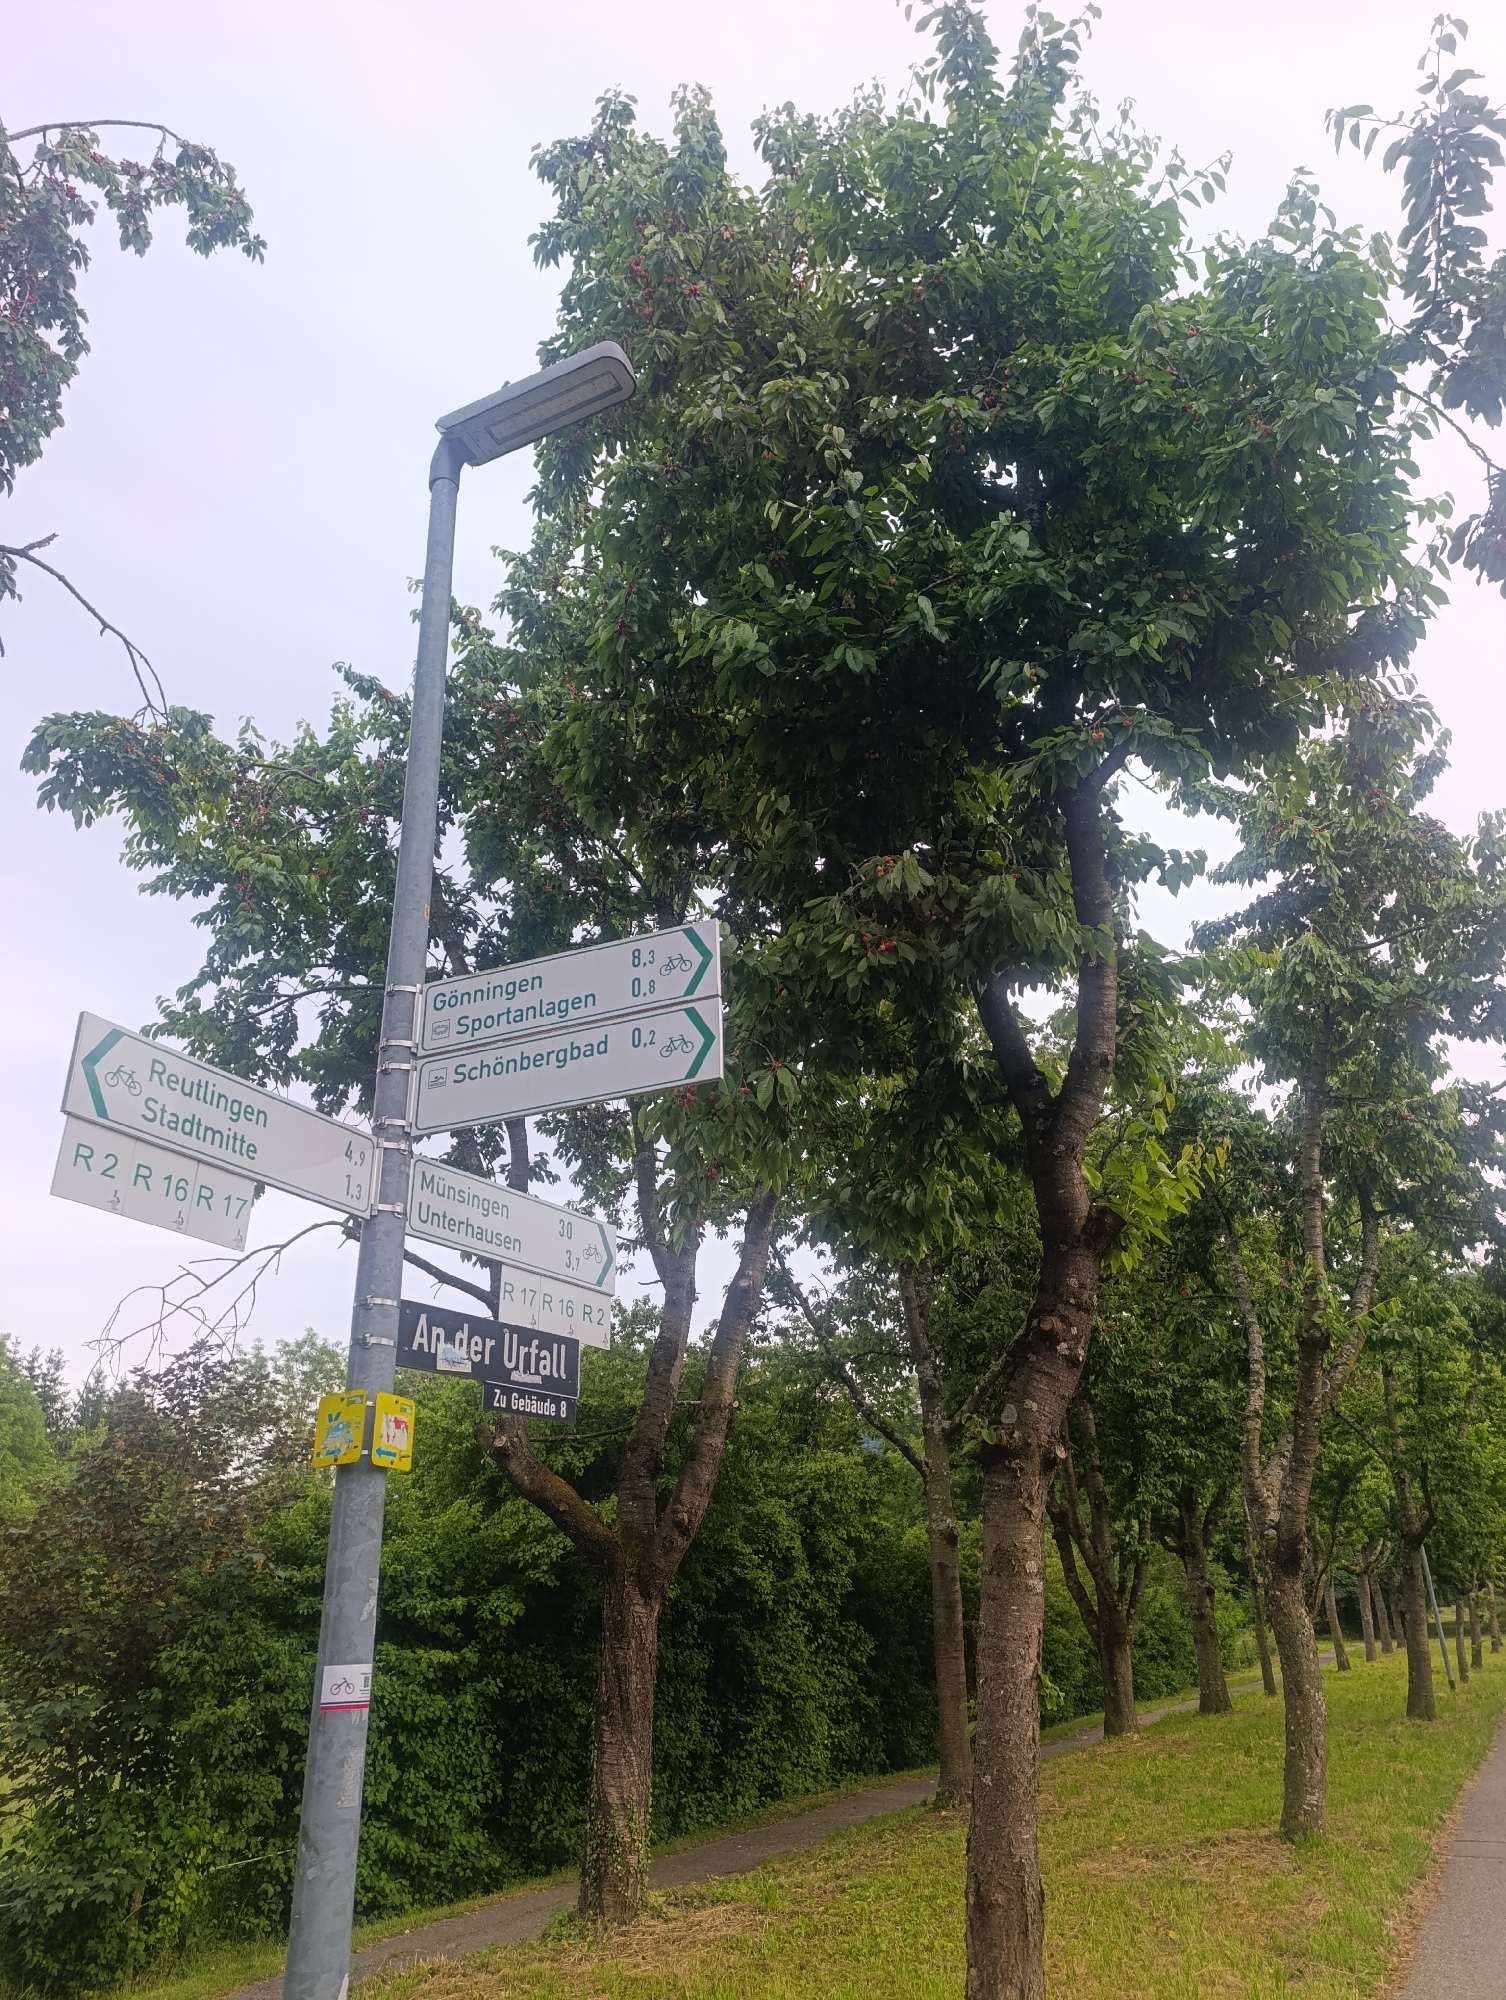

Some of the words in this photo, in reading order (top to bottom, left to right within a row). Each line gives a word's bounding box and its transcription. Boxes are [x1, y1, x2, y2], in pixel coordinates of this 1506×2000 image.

[631, 949, 655, 968] 8,3
[433, 975, 543, 1011] Gönningen
[631, 977, 656, 998] 0,8
[456, 993, 597, 1037] Sportanlagen
[631, 1027, 656, 1048] 0,2
[453, 1034, 608, 1083] Schönbergbad
[149, 1058, 268, 1127] Reutlingen
[141, 1097, 258, 1161] Stadtmitte
[73, 1142, 95, 1172] R
[100, 1153, 119, 1179] 2
[344, 1141, 366, 1167] 4,9
[133, 1163, 153, 1191] R
[163, 1174, 189, 1202] 16
[345, 1174, 362, 1200] 1,3
[420, 1171, 509, 1219] Münsingen
[195, 1185, 214, 1211] R
[223, 1194, 248, 1220] 17
[418, 1202, 522, 1253] Unterhausen
[558, 1219, 573, 1240] 30
[503, 1282, 514, 1302] R
[521, 1286, 537, 1308] 17
[542, 1293, 553, 1312] R
[559, 1299, 574, 1318] 16
[583, 1303, 593, 1323] R
[597, 1308, 605, 1326] 2
[412, 1313, 445, 1354] An
[455, 1323, 496, 1365] der
[503, 1331, 567, 1380] Urfall
[493, 1389, 507, 1408] Zu
[511, 1392, 556, 1418] Gebäude
[560, 1401, 567, 1418] 8
